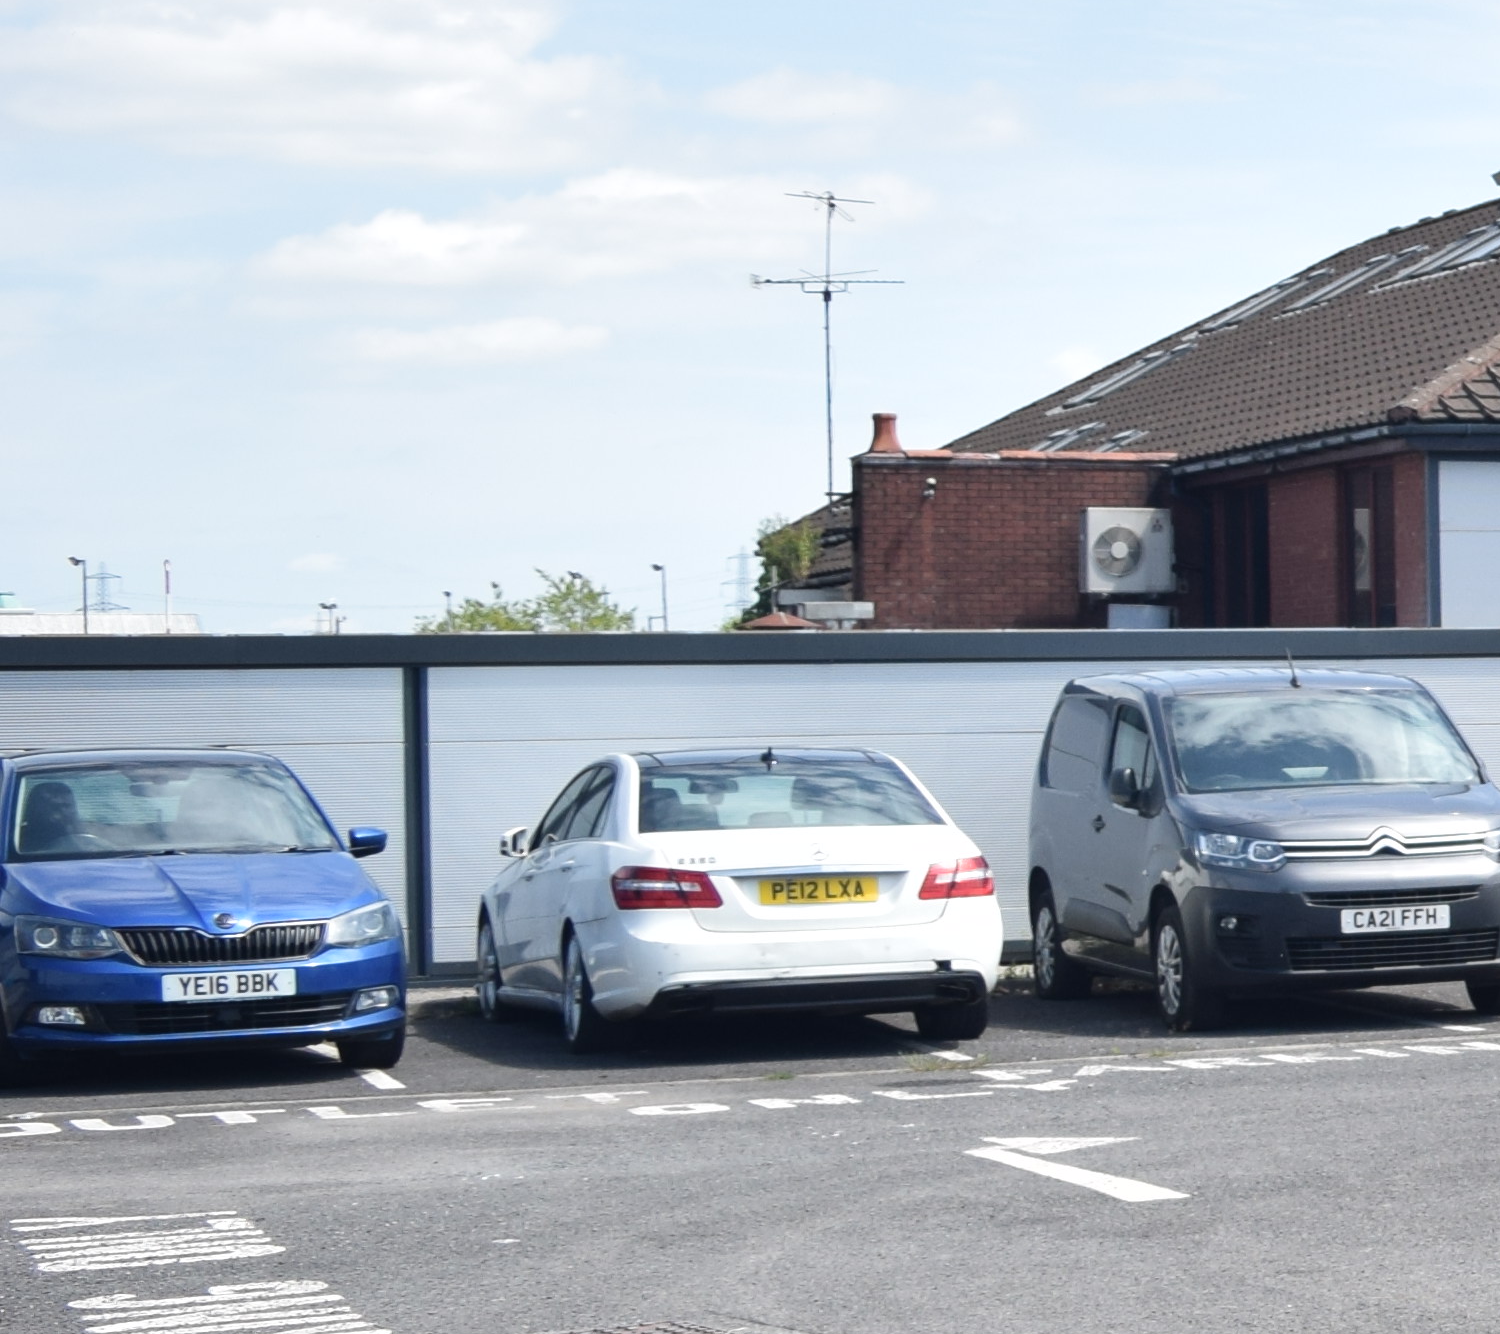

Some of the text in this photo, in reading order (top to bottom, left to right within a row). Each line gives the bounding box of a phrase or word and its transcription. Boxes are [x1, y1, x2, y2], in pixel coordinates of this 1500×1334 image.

[771, 879, 865, 900] PE12 LXA
[1353, 908, 1438, 929] CA21 FFH
[178, 973, 280, 997] YE16 BBK
[627, 1078, 1080, 1116] ONLY
[9, 1210, 287, 1272] ONLY
